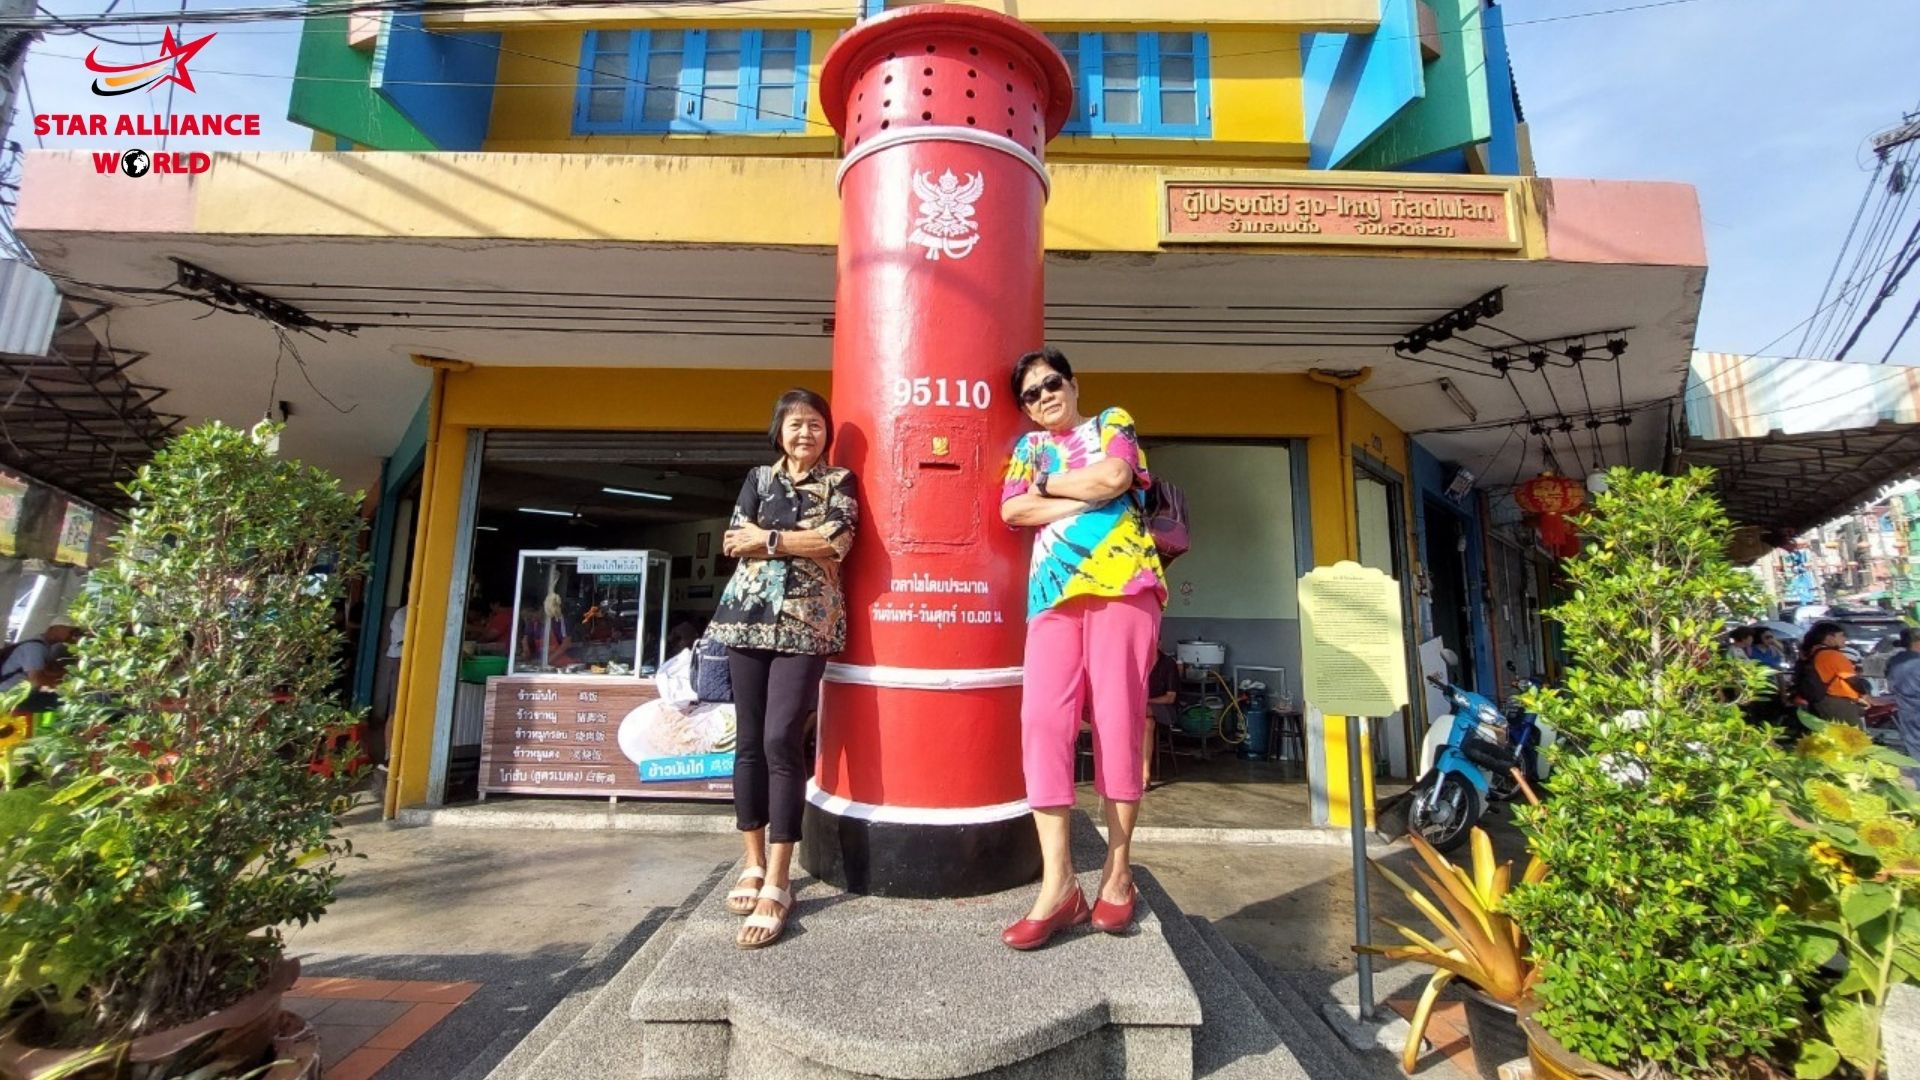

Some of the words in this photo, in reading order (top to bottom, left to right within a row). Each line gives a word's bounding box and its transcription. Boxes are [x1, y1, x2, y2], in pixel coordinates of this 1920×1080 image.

[1182, 188, 1290, 221] ตู้ไปรษณีย์
[1227, 217, 1322, 234] อำเภอเบตง
[1355, 220, 1456, 238] จังหวัดยะลา
[893, 376, 991, 409] 95110
[890, 572, 989, 594] เวลาไขโดยประมาณ
[872, 602, 958, 629] วันจันทร์-วันศุกร์
[961, 610, 992, 623] 10.00
[994, 610, 1004, 623] น.
[648, 759, 705, 777] ข้าวมันไก่
